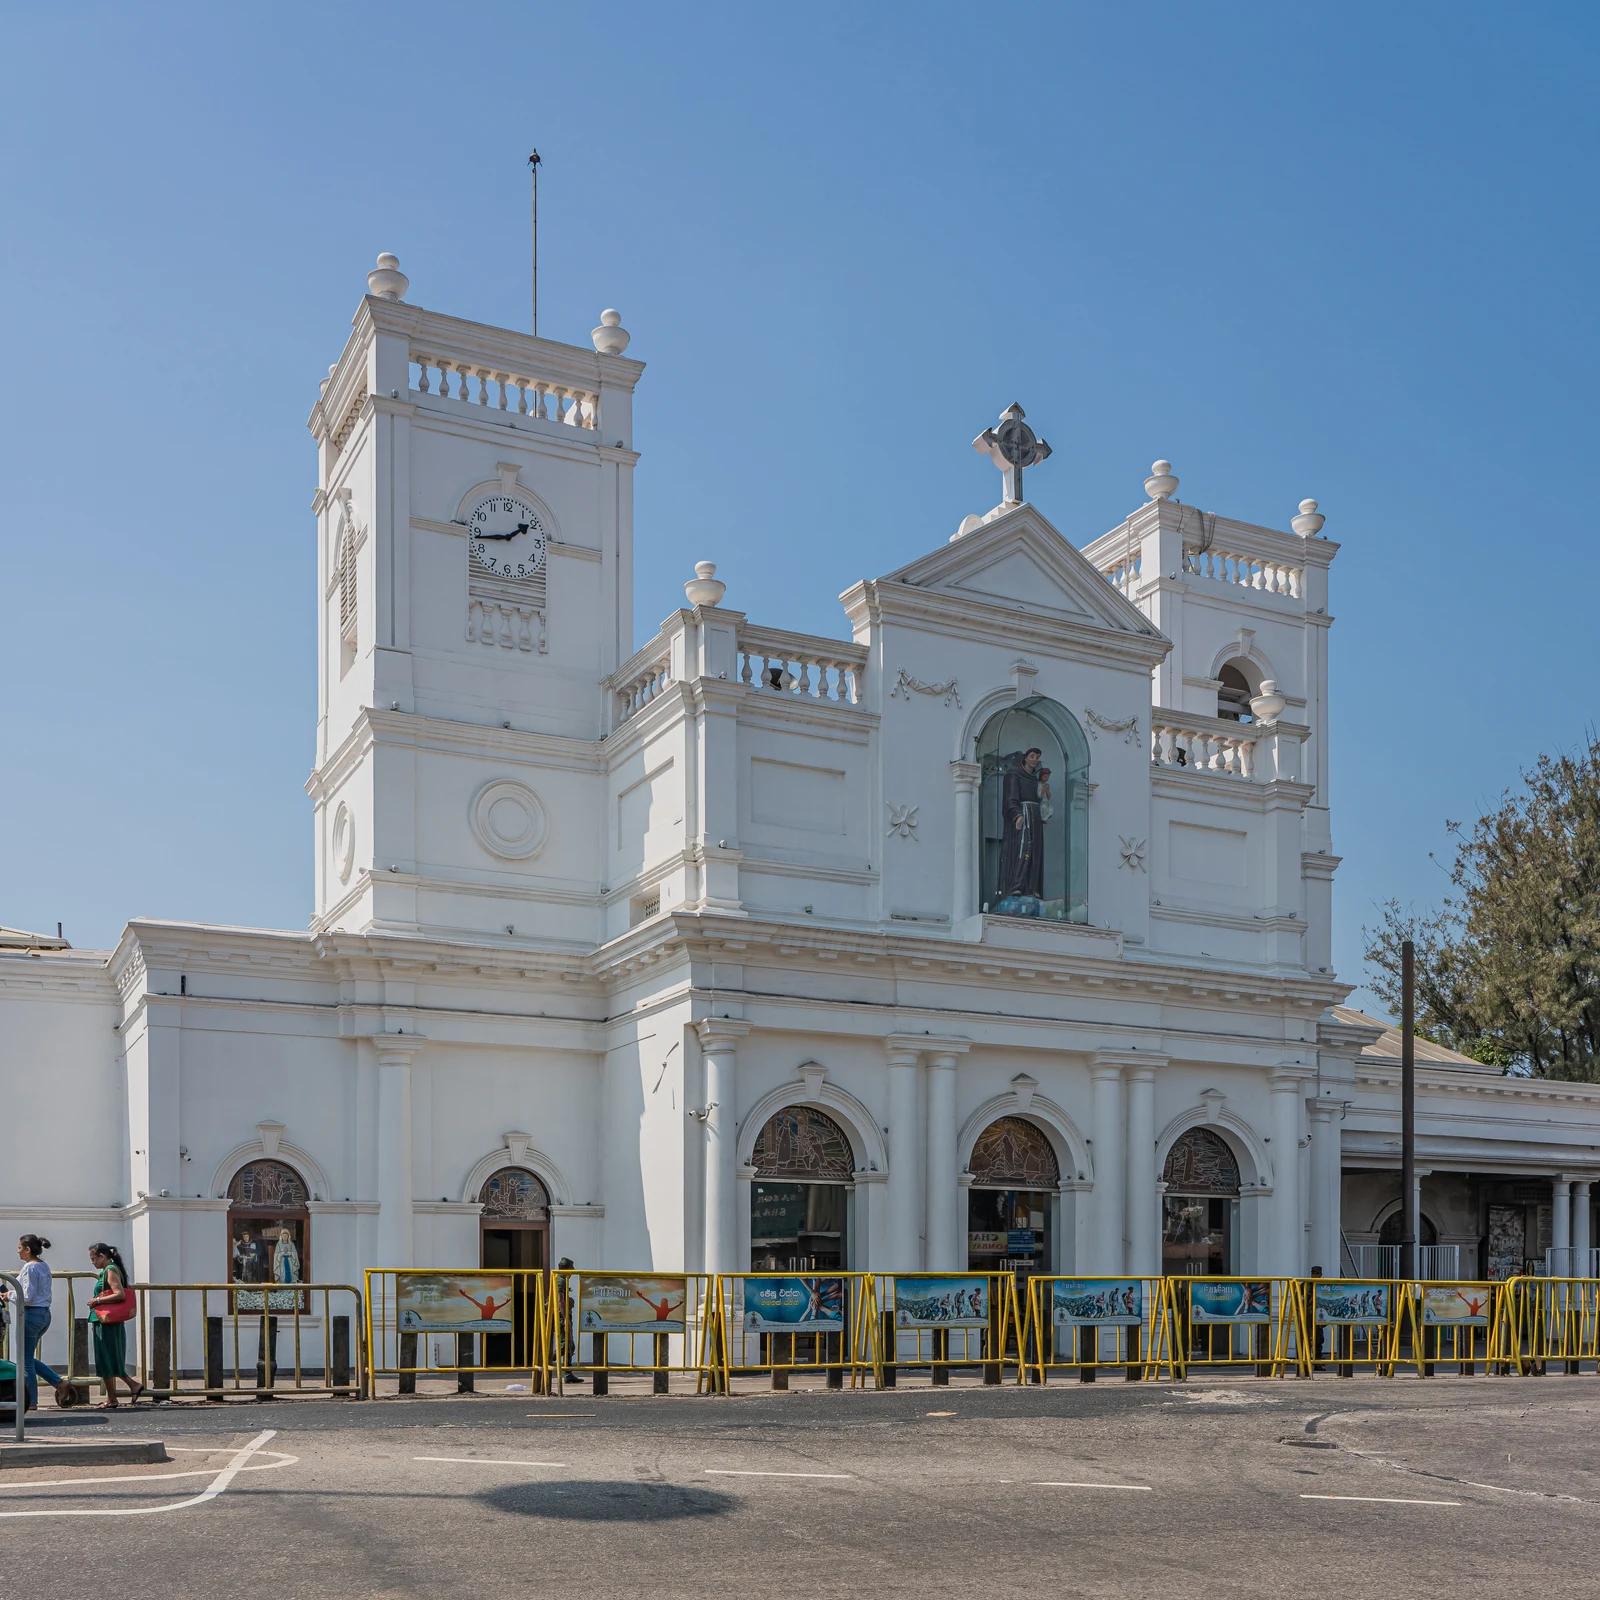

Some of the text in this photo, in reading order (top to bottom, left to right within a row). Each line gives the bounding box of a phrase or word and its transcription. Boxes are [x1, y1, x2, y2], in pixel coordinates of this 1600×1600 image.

[490, 503, 496, 512] 11
[503, 502, 513, 512] 12
[477, 512, 487, 522] 10
[521, 510, 525, 519] 1
[530, 519, 537, 530] 2
[473, 527, 481, 537] 9
[477, 543, 485, 553] 8
[534, 539, 541, 549] 3
[489, 557, 497, 567] 7
[528, 553, 535, 563] 4
[503, 564, 511, 574] 6
[517, 564, 525, 574] 5
